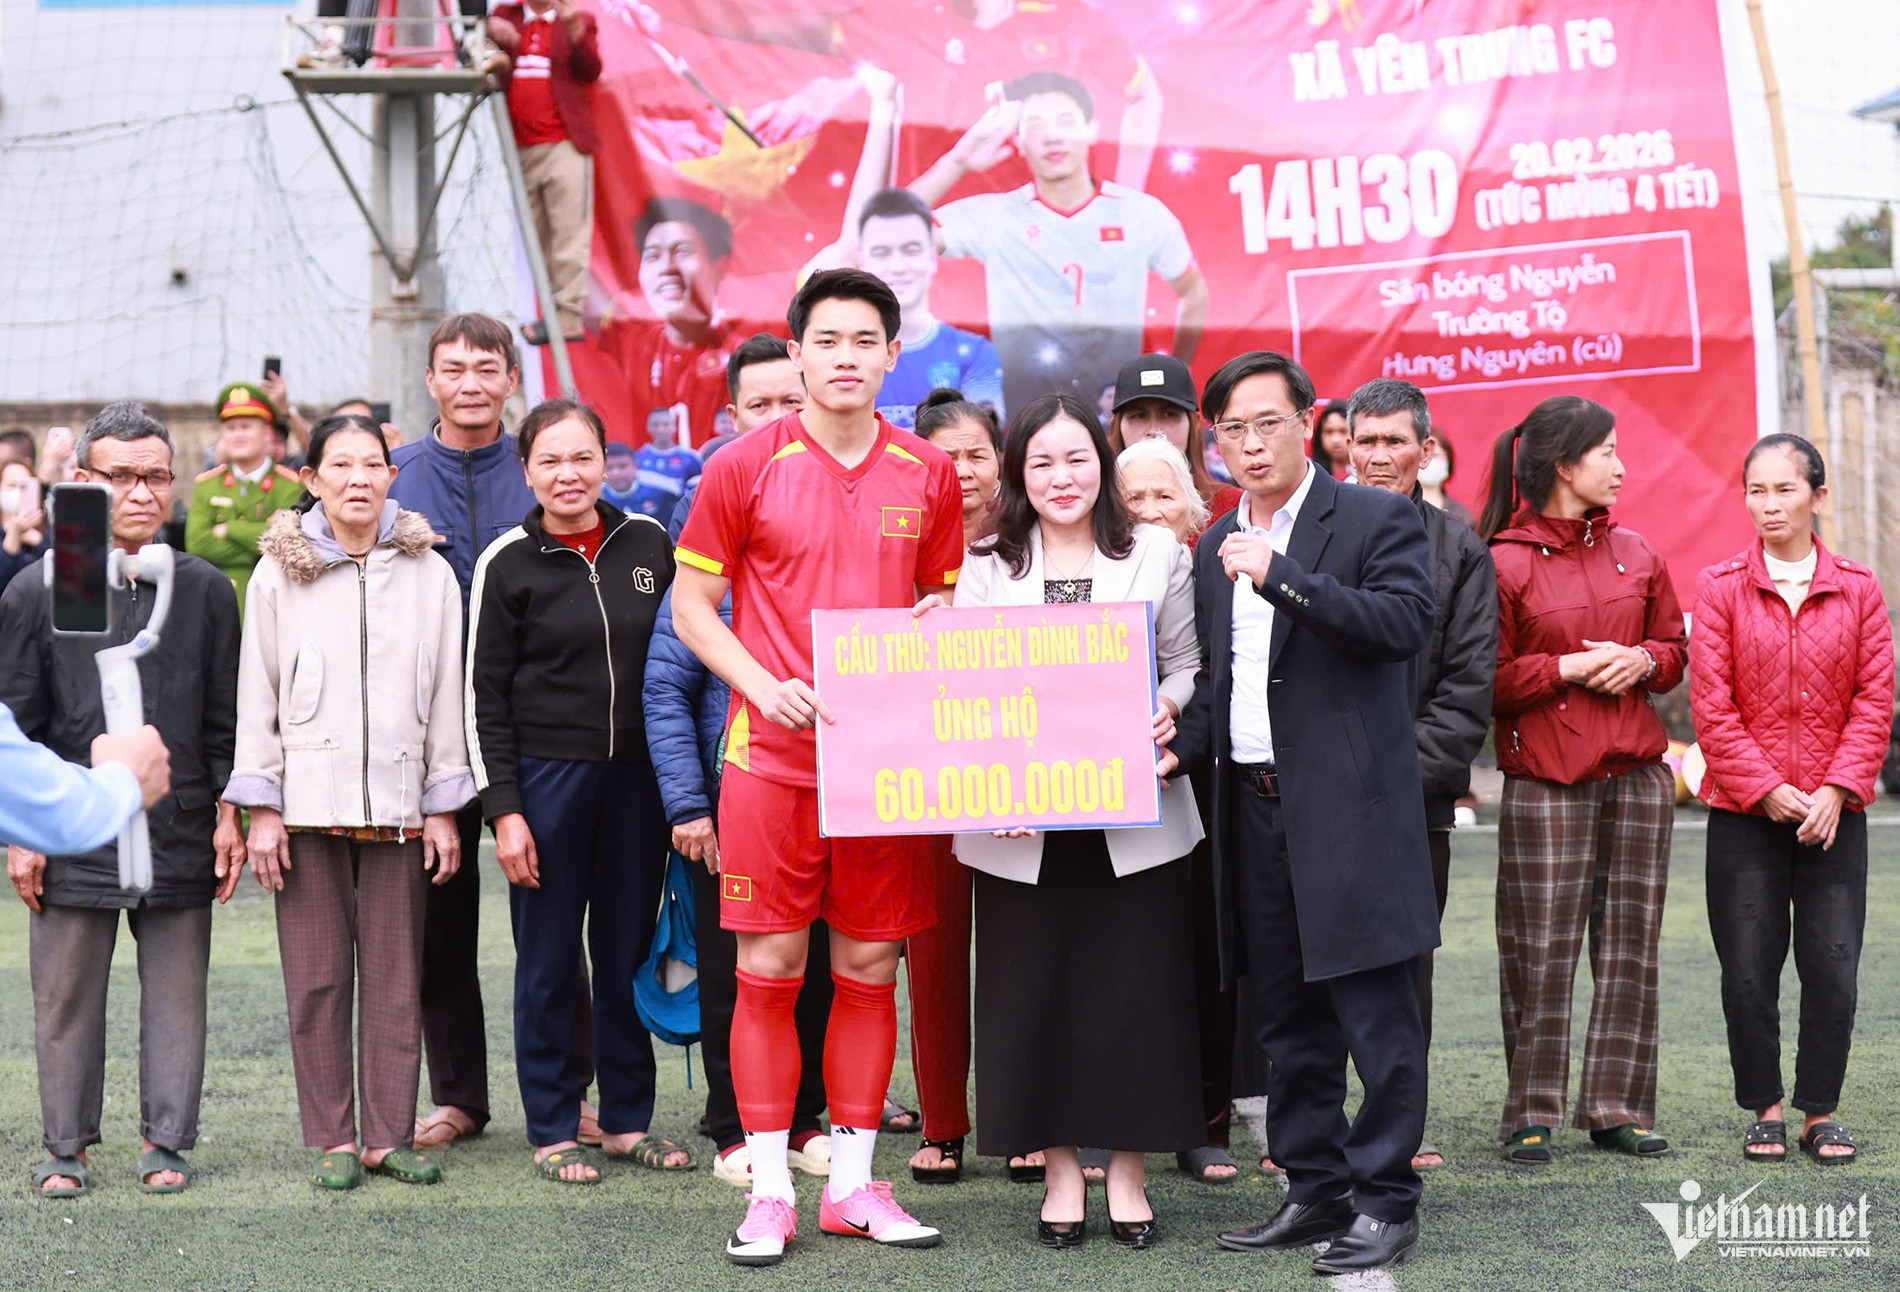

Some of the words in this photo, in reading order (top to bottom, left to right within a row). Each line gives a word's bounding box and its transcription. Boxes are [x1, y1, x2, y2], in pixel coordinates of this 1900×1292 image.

[1353, 32, 1430, 96] YÊN
[1565, 17, 1617, 70] FC
[1510, 129, 1675, 180] 20.02.2026
[1229, 149, 1459, 254] 14H30
[1634, 174, 1657, 212] 4
[1658, 162, 1720, 209] TẾT)
[1433, 270, 1508, 302] bóng
[1509, 253, 1616, 298] Nguyễn
[1431, 307, 1531, 339] Trường
[1530, 300, 1567, 332] Tộ
[1461, 341, 1566, 377] Nguyên
[1572, 333, 1623, 366] (cũ)
[632, 567, 655, 593] G
[882, 617, 931, 673] THỦ:
[937, 613, 1023, 671] NGUYỄN
[1028, 618, 1081, 665] ĐÌNH
[1085, 607, 1129, 664] BẮC
[933, 684, 992, 743] ỦNG
[1002, 685, 1039, 747] HỘ
[874, 757, 1125, 823] 60.000.000đ
